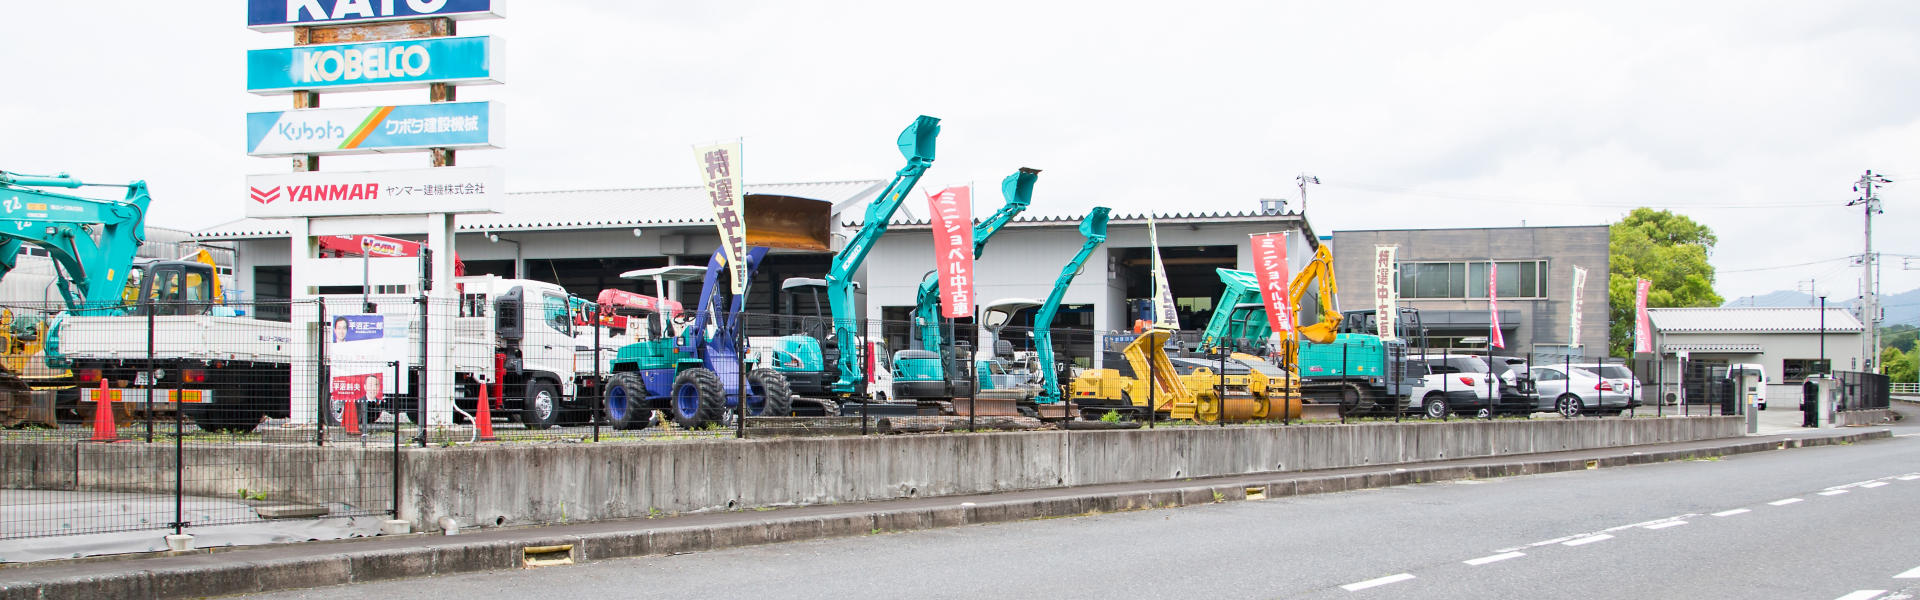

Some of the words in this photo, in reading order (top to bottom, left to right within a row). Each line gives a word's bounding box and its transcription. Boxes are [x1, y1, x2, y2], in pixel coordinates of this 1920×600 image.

[303, 45, 430, 82] KOBELCO
[278, 121, 345, 141] Kubota
[385, 115, 479, 135] クボタ建設機械
[286, 183, 379, 202] YANMAR
[386, 183, 485, 197] ヤンマー建機株式会社
[940, 192, 969, 316] ミニショベル中古車
